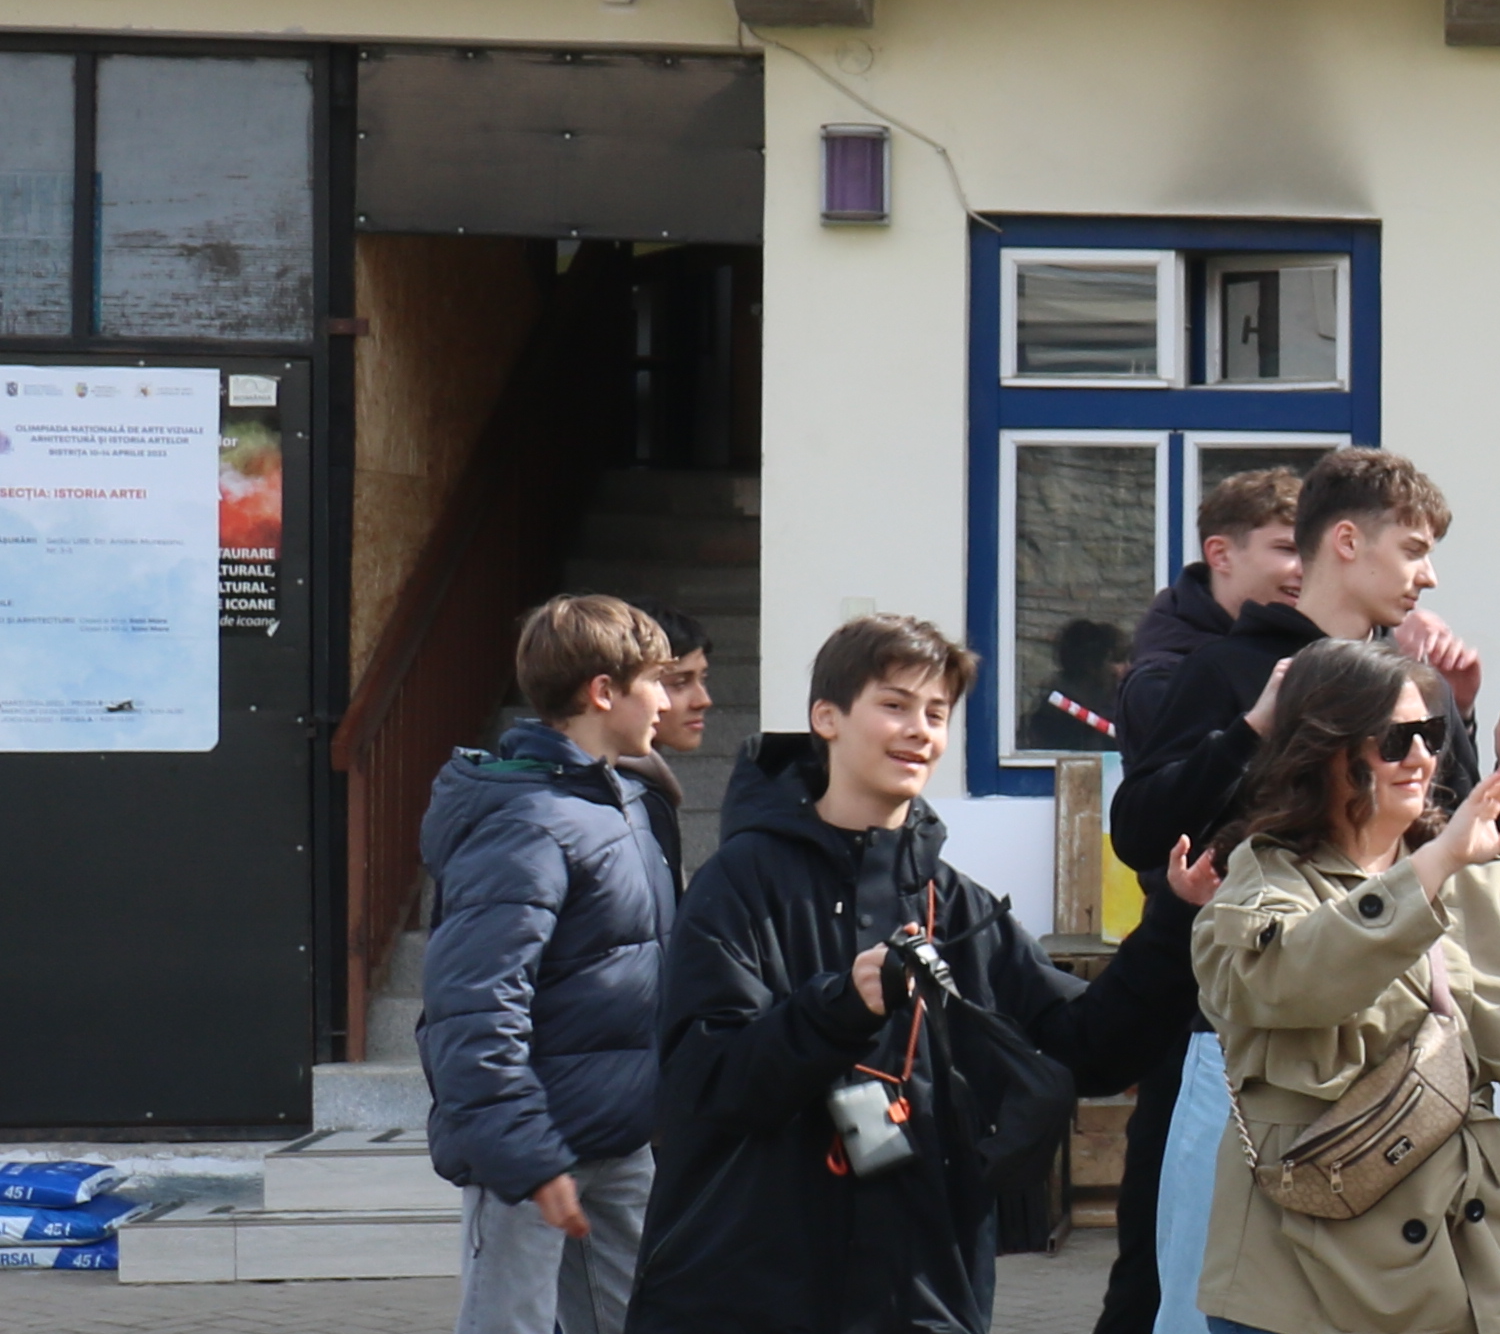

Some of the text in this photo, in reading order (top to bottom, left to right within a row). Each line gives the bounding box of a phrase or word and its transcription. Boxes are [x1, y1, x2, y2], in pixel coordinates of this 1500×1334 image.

[15, 425, 69, 433] OLIMPIADA
[127, 426, 139, 434] DE
[141, 426, 165, 434] ARTE
[54, 488, 107, 499] ISTORIA
[109, 489, 146, 499] ARTEI
[225, 598, 276, 611] ICOANE
[4, 1185, 25, 1200] 45
[43, 1223, 63, 1236] 45
[72, 1254, 92, 1267] 45
